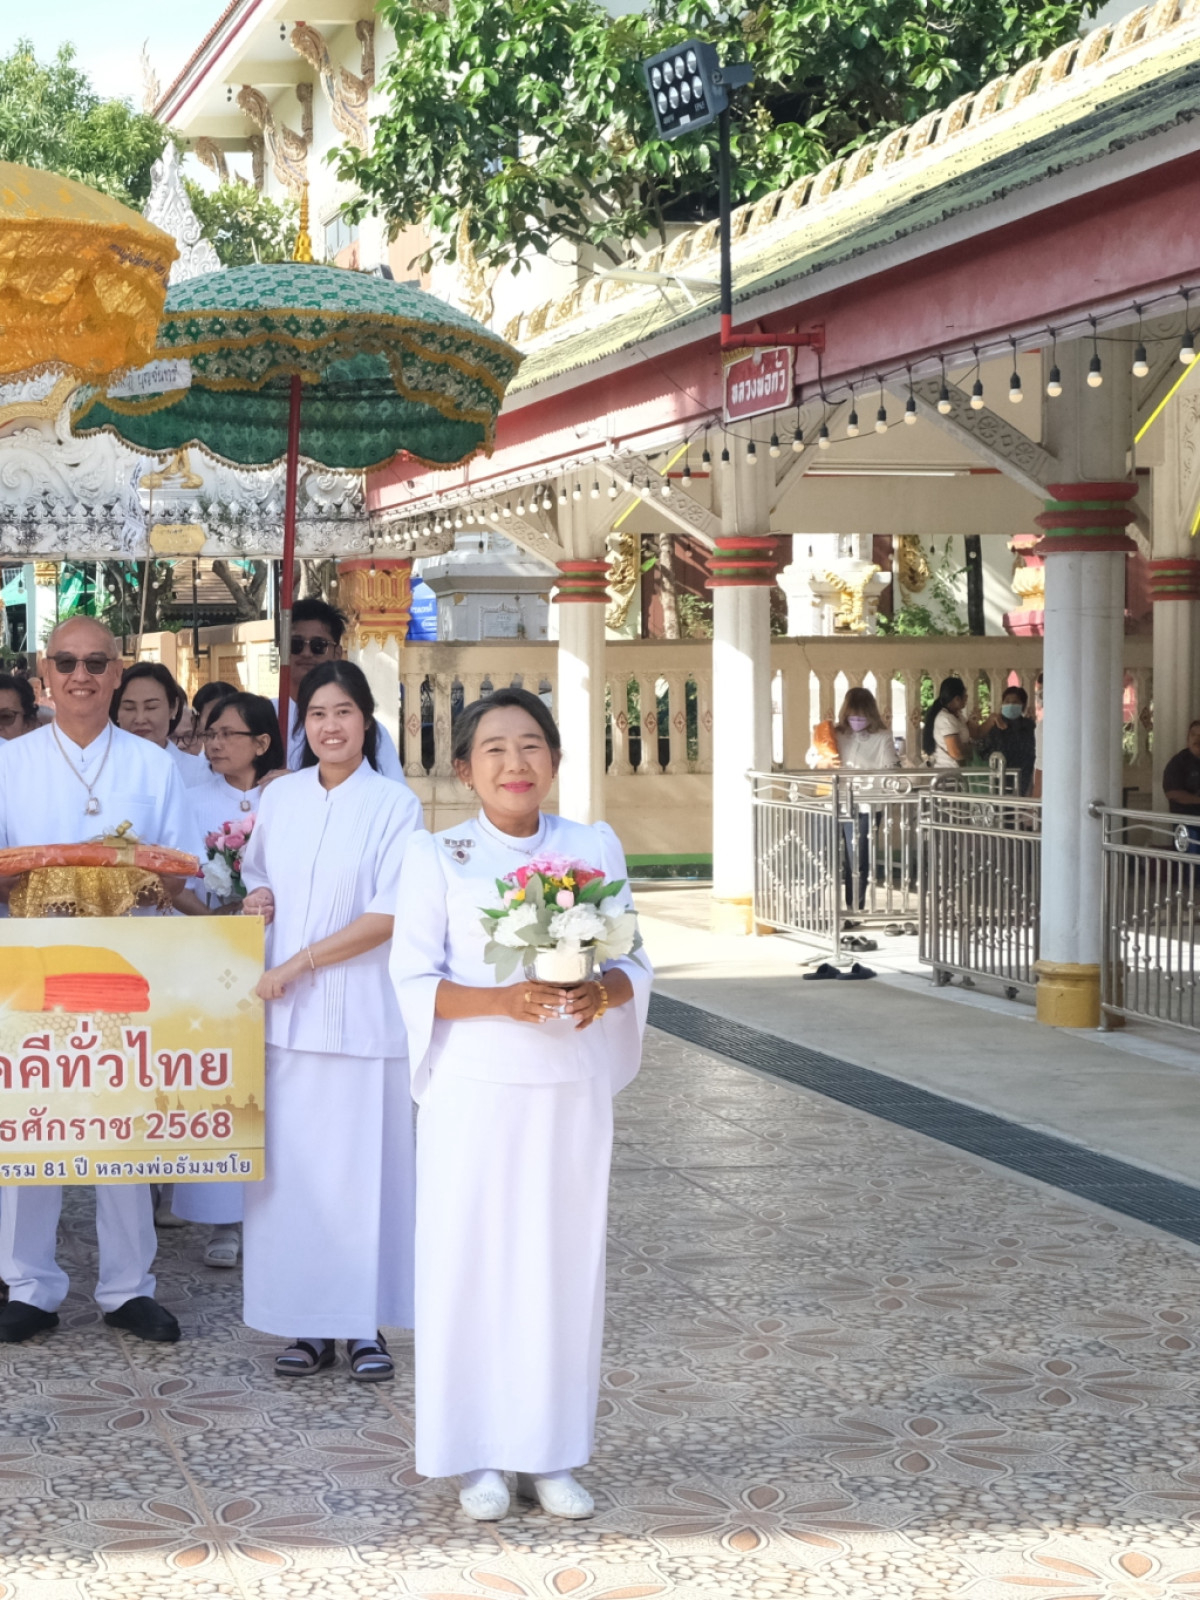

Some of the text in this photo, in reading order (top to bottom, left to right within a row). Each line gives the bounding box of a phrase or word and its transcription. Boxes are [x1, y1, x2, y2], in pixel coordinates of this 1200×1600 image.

[146, 1112, 231, 1139] 2568
[43, 1161, 66, 1177] 81
[74, 1155, 90, 1177] ปี
[96, 1152, 251, 1176] หลวงพ่อธัมมชโย
